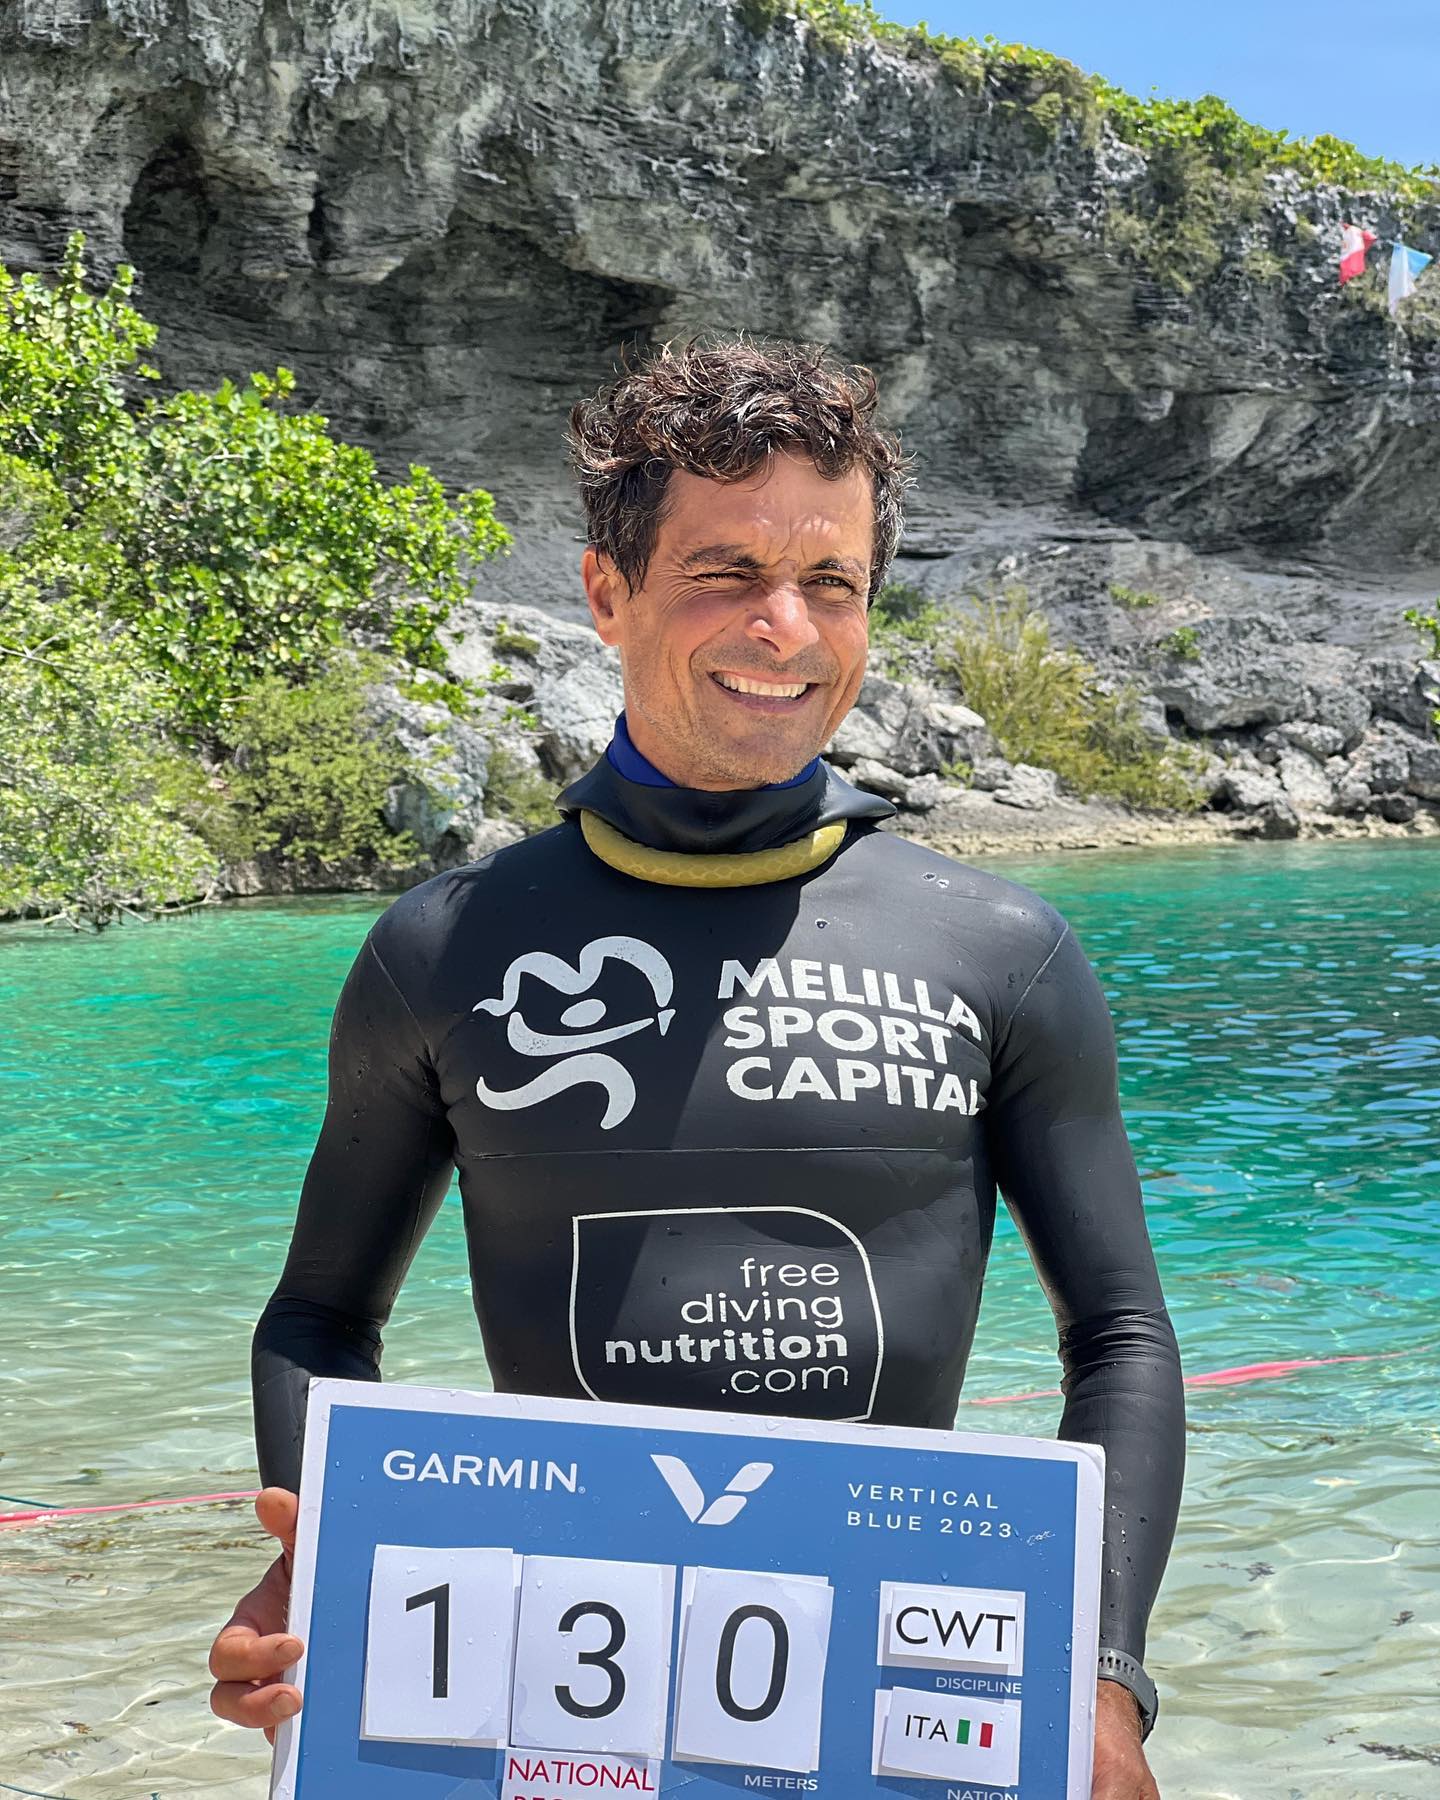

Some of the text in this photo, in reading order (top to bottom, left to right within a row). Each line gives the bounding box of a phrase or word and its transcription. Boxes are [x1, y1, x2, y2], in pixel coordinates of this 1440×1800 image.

[718, 958, 982, 1041] MELILLA
[723, 1006, 952, 1065] SPORT
[740, 1258, 840, 1288] free
[681, 1291, 844, 1329] diving
[605, 1328, 848, 1364] nutrition
[720, 1366, 849, 1394] .com
[848, 1483, 998, 1509] VERTICAL
[847, 1511, 1012, 1538] BLUE 2023
[896, 1606, 1016, 1652] CWT
[936, 1676, 1022, 1695] DISCIPLINE
[905, 1714, 949, 1743] ITA
[508, 1758, 655, 1791] NATIONAL
[744, 1774, 818, 1791] METERS
